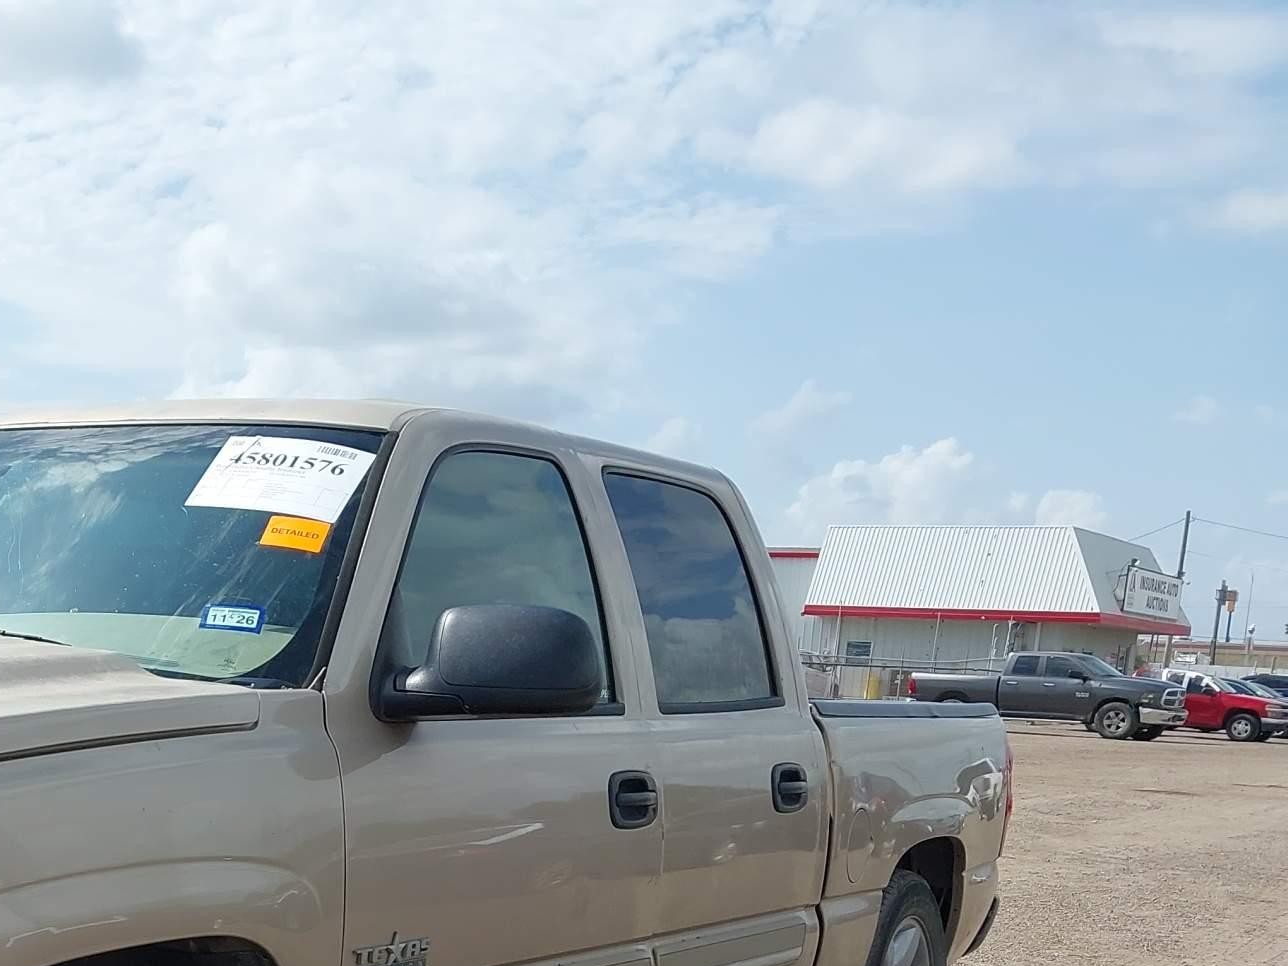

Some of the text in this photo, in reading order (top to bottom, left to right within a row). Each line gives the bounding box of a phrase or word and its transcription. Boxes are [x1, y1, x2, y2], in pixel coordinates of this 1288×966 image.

[229, 451, 349, 477] 45801576
[271, 527, 320, 539] DETAILED
[1139, 575, 1167, 595] INSURANCE
[236, 615, 255, 626] 26
[352, 930, 431, 966] TEXAS
